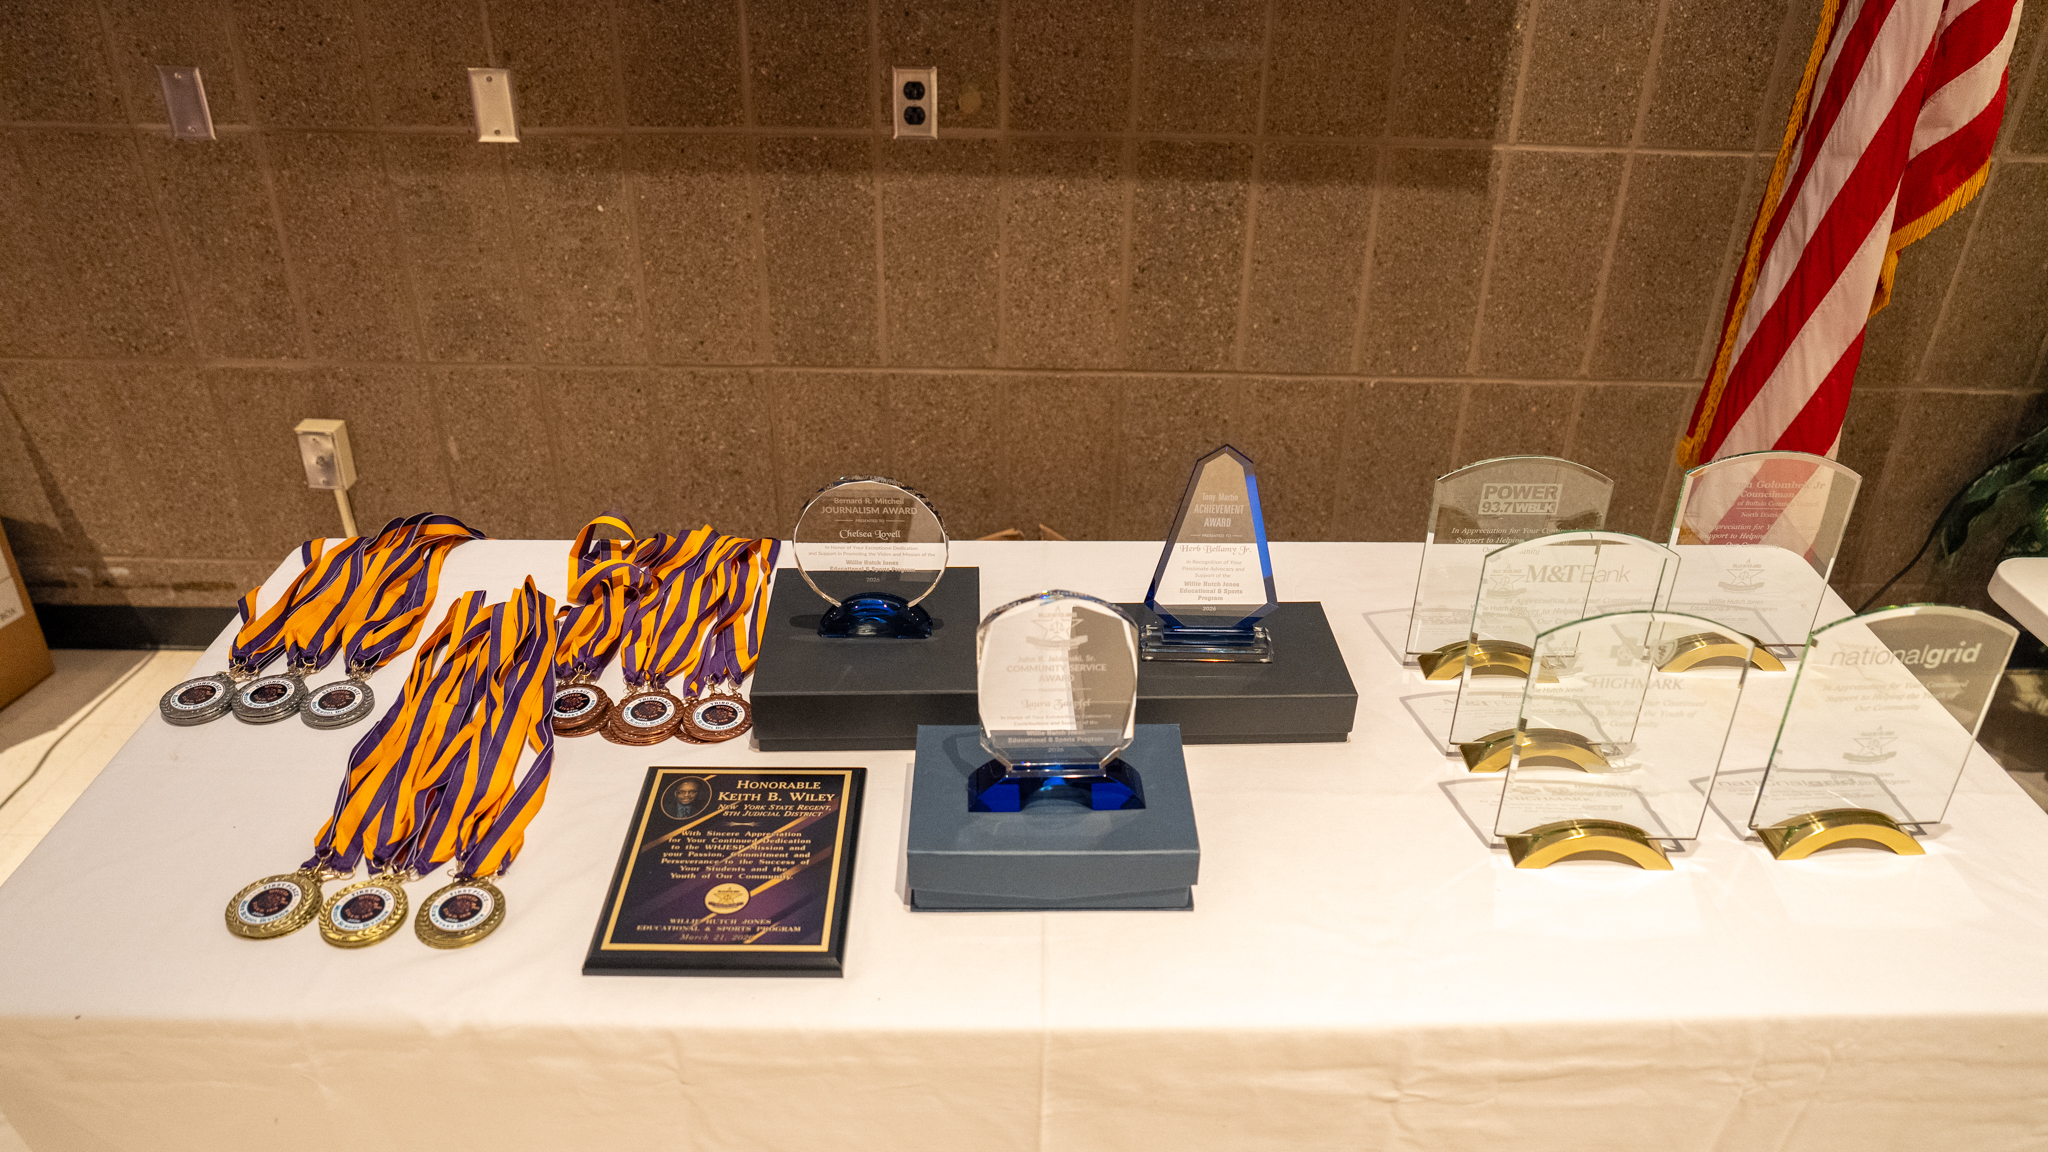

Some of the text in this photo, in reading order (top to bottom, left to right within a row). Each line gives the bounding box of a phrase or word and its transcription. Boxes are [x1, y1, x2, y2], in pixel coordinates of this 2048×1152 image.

[1813, 481, 1826, 490] Jr
[1484, 486, 1558, 500] POWER
[1740, 490, 1795, 498] Councilman
[821, 506, 918, 515] JOURNALISM AWARD
[1194, 504, 1244, 514] ACHIEVEMENT
[1482, 502, 1556, 512] 93.7 WBLK
[1204, 518, 1232, 528] AWARD
[839, 530, 900, 540] Chelsea Lovell
[1461, 528, 1507, 536] Appreciation
[1508, 528, 1521, 536] for
[1455, 536, 1485, 544] Support
[1496, 536, 1525, 545] Helpin
[1180, 544, 1252, 555] Herb Bellamy Jr.
[1524, 564, 1631, 583] M&T Bank
[1830, 640, 1982, 669] nationalgrid
[1006, 664, 1107, 673] COMMUNITY SERVICE
[1039, 674, 1074, 682] AWARD
[736, 780, 821, 790] HONORABLE
[717, 792, 836, 802] KEITH B. WILEY
[681, 830, 802, 838] With Sincere Appreciation
[670, 872, 697, 880] Youth
[701, 872, 711, 880] of
[715, 872, 733, 880] Our
